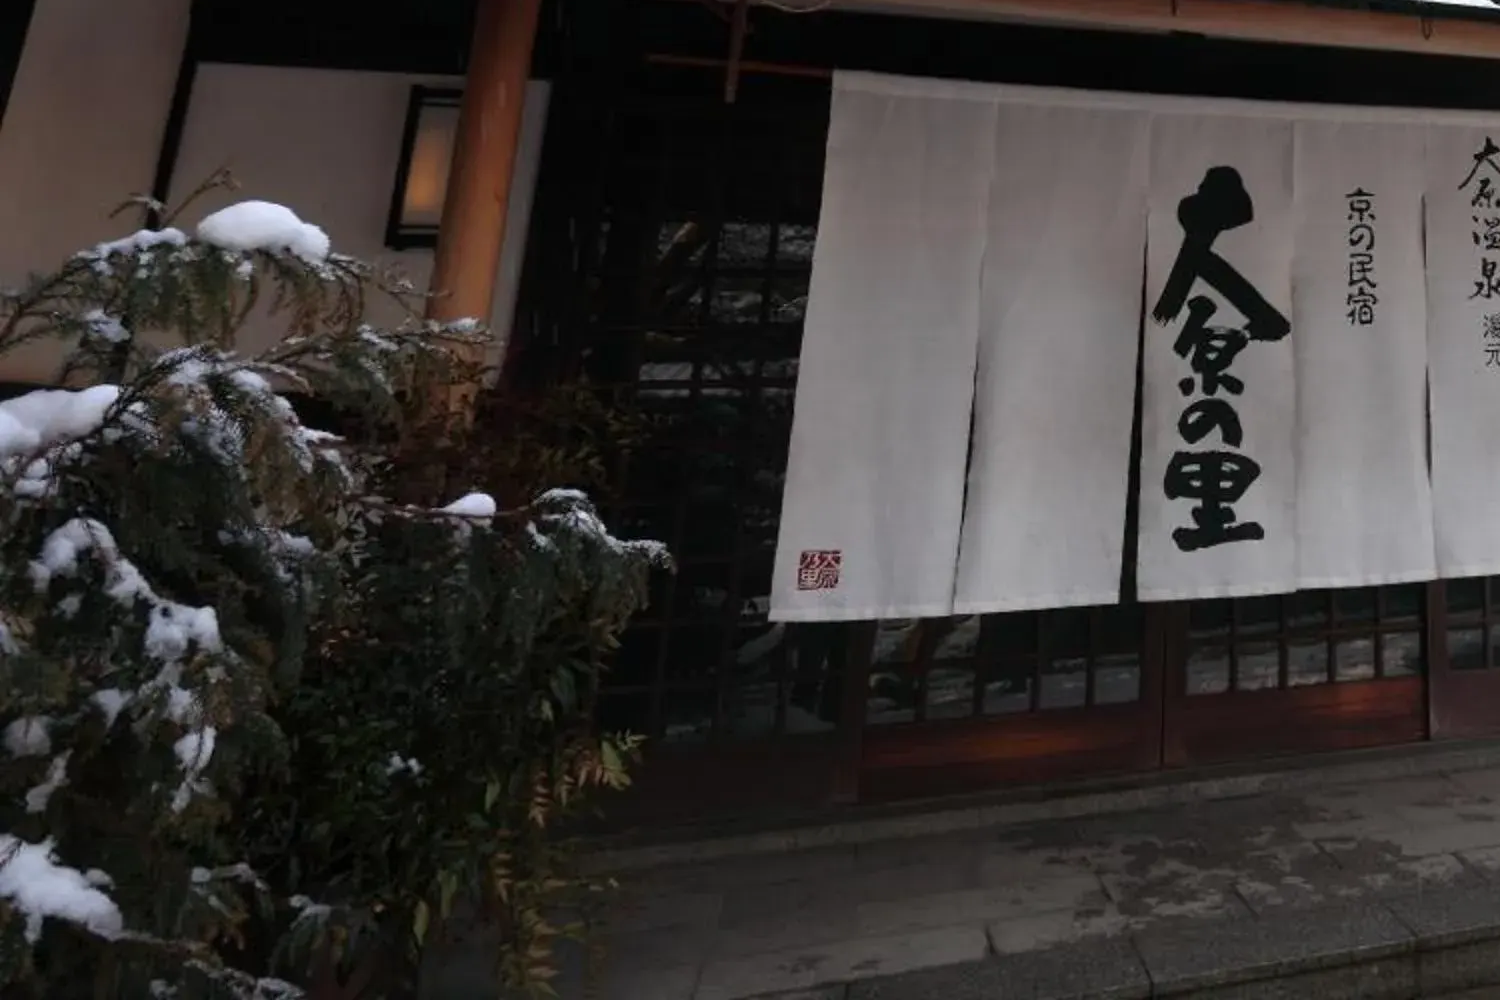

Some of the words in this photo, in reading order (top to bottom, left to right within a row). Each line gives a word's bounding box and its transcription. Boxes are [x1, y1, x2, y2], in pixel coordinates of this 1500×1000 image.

[1151, 164, 1291, 553] 大原の里
[1345, 186, 1379, 326] 京の民宿
